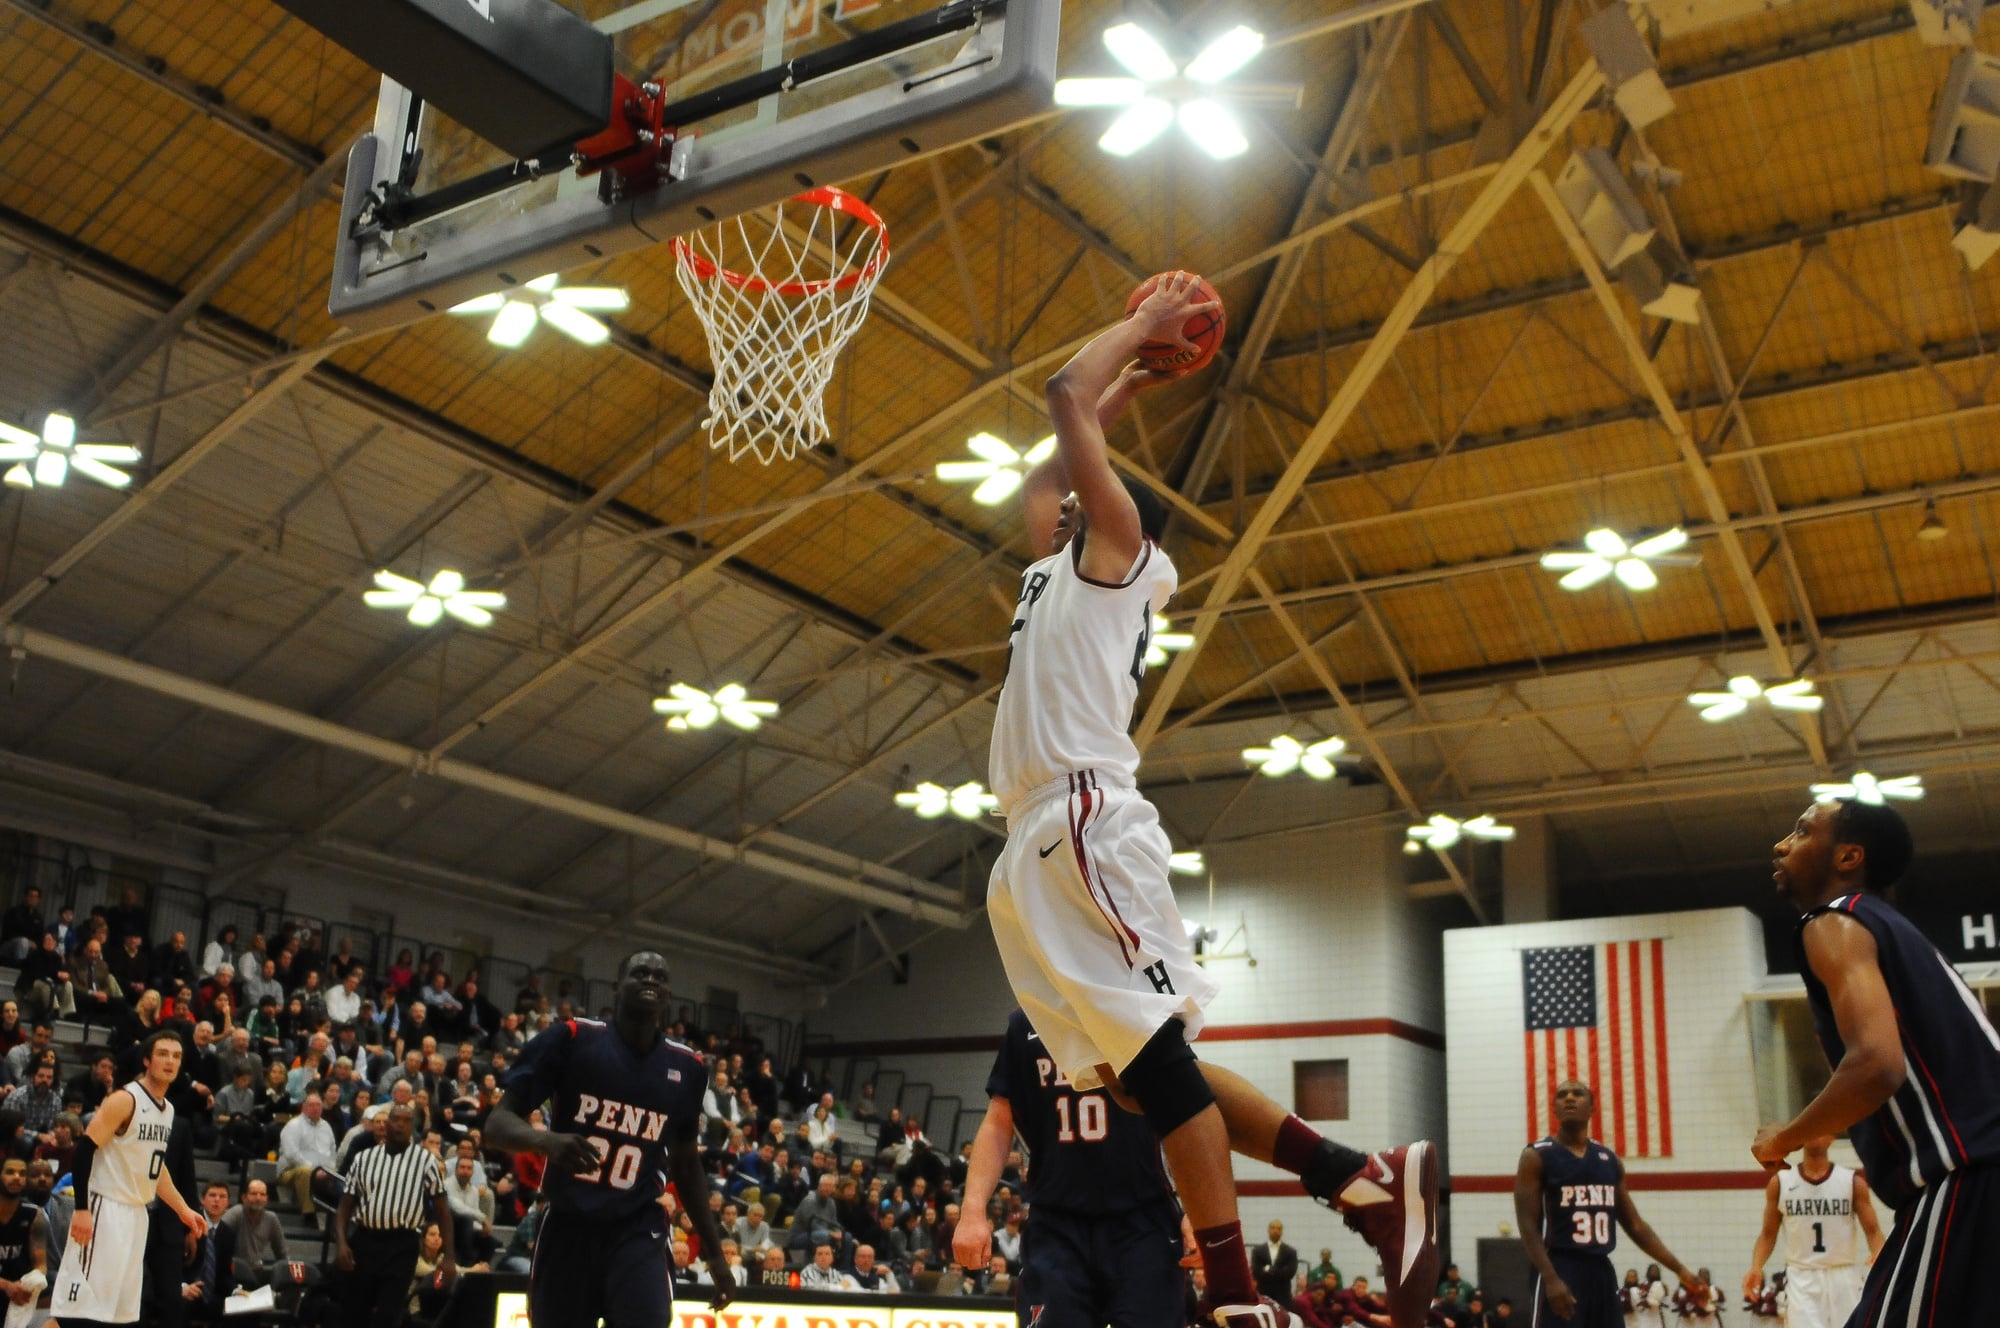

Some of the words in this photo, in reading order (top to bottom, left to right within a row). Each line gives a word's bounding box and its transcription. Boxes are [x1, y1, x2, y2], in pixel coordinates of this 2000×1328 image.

[1961, 913, 2000, 950] H
[1142, 958, 1177, 996] H
[574, 1093, 669, 1142] PENN
[1056, 1095, 1108, 1142] 10
[148, 1149, 165, 1180] 0
[573, 1135, 643, 1191] 20
[1560, 1184, 1615, 1207] PENN
[1785, 1198, 1850, 1216] HARVARD
[1572, 1210, 1610, 1245] 30
[1812, 1222, 1826, 1253] 1
[68, 1282, 81, 1302] H
